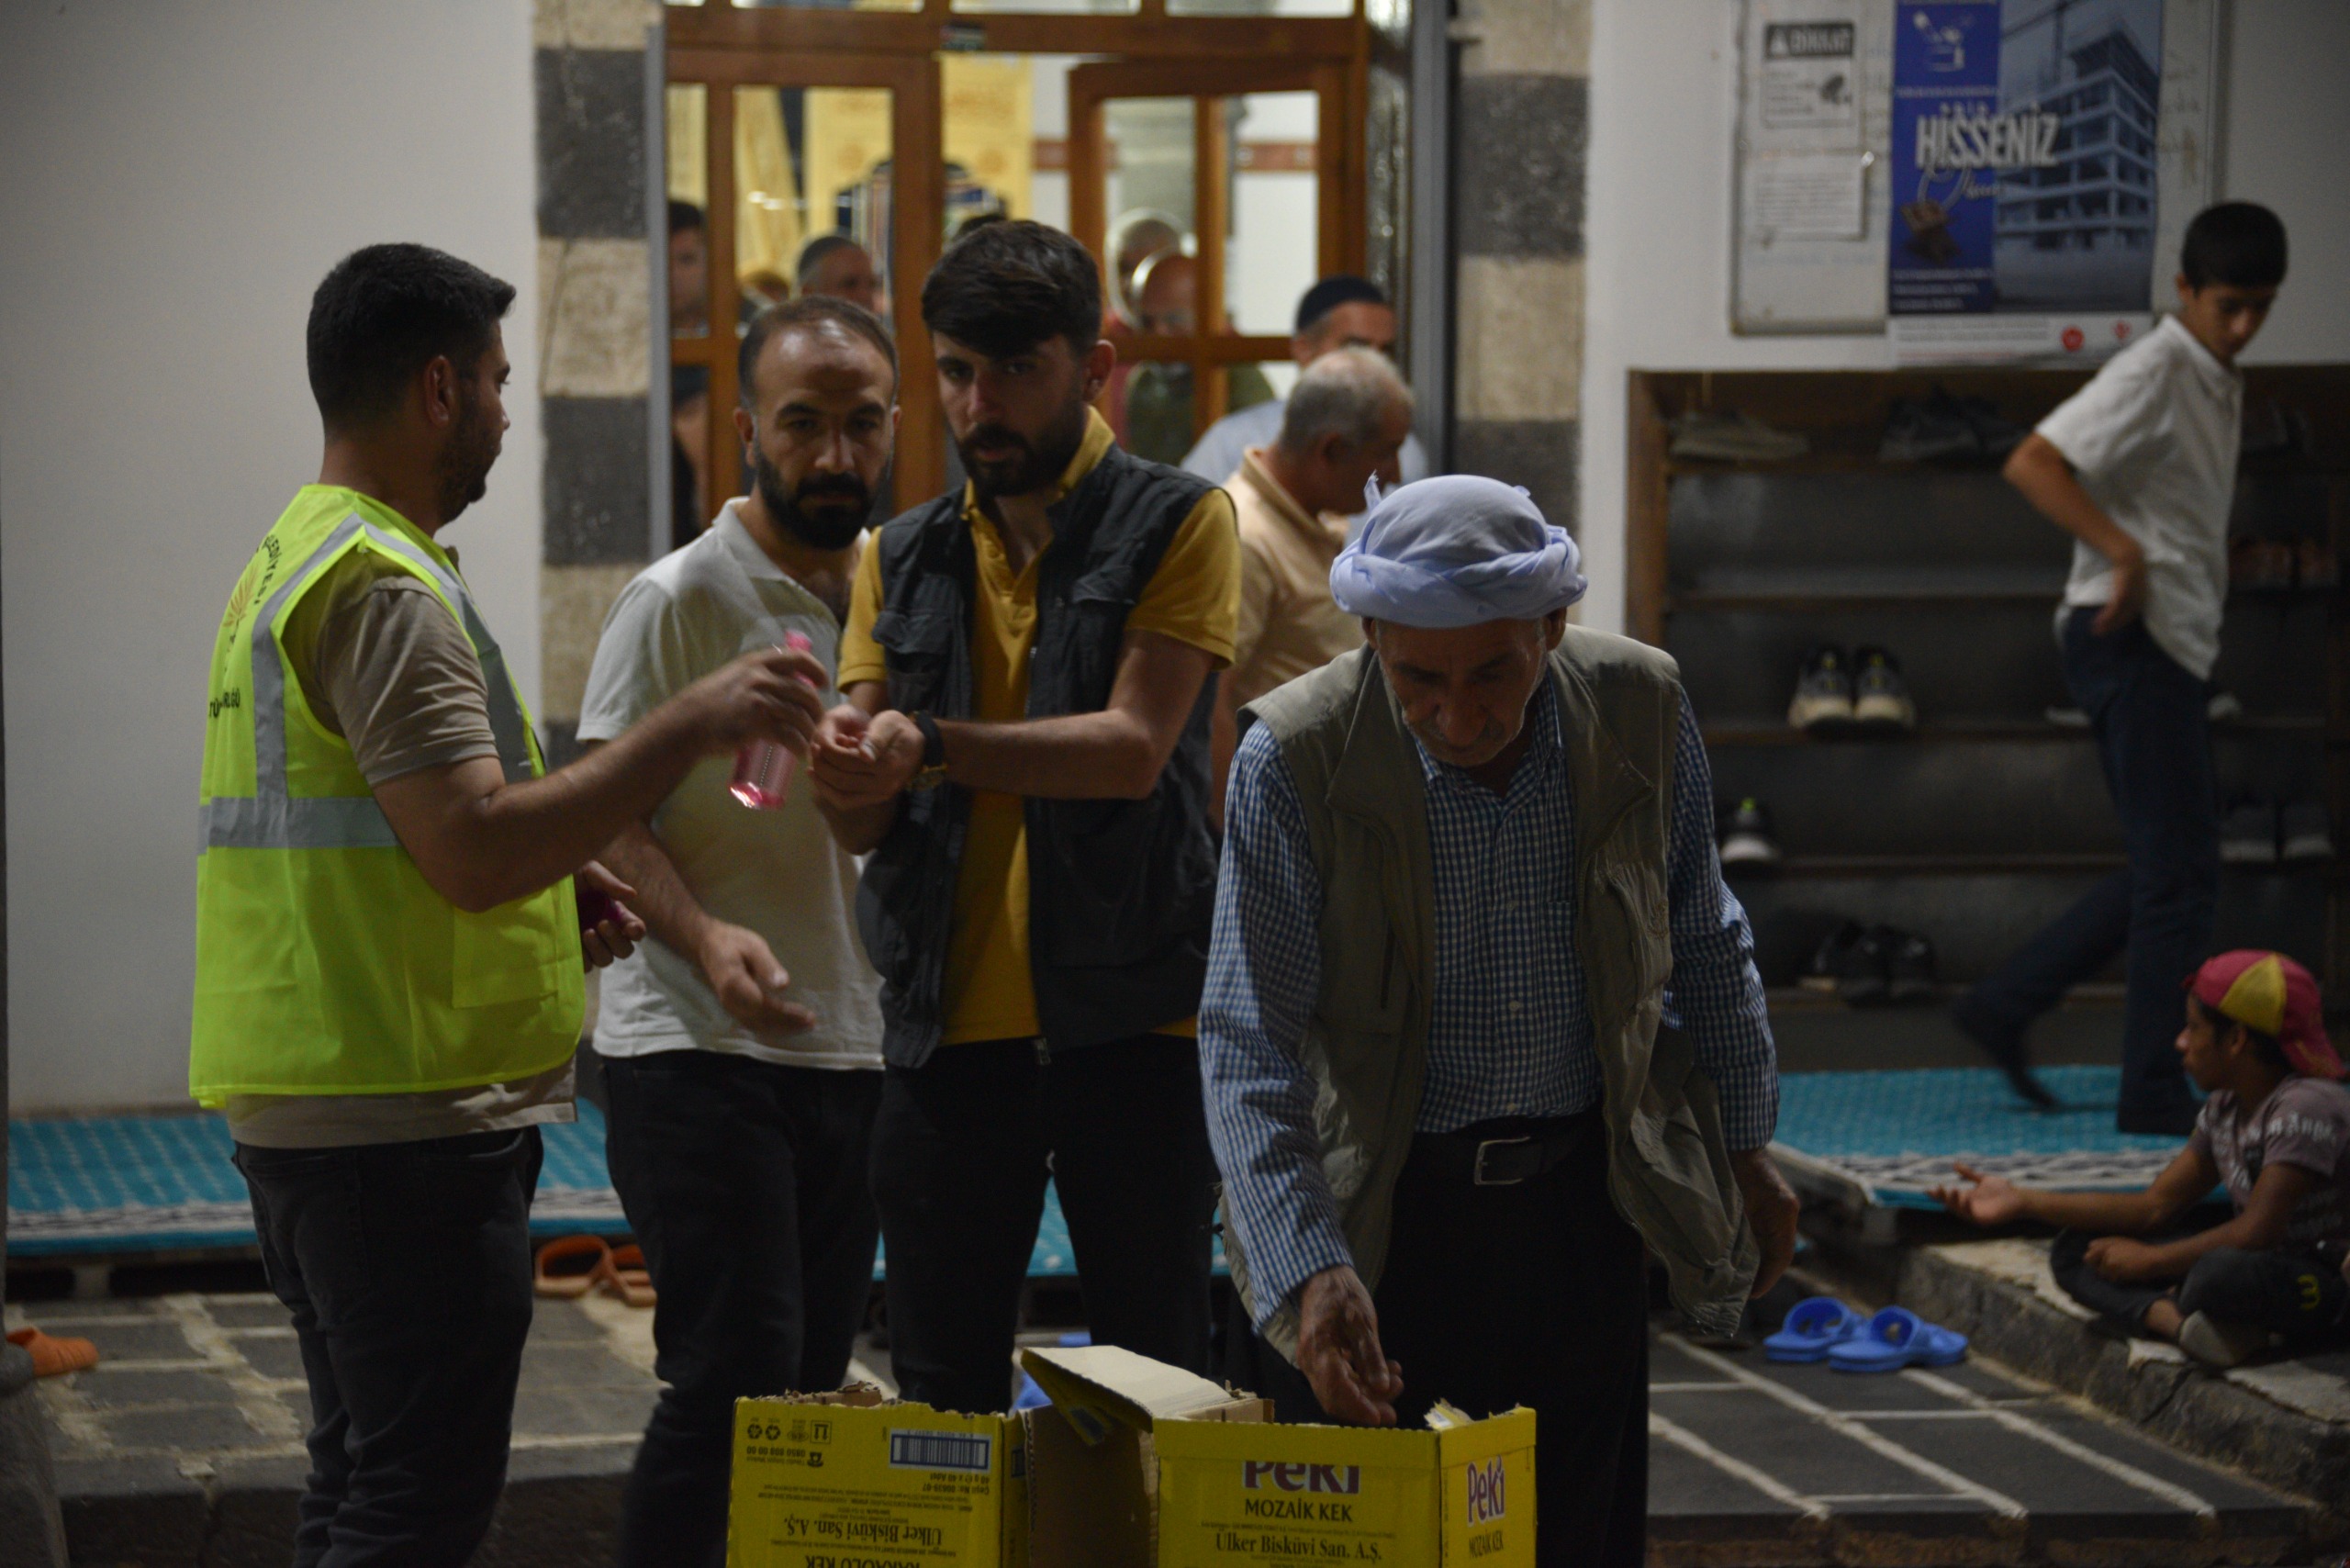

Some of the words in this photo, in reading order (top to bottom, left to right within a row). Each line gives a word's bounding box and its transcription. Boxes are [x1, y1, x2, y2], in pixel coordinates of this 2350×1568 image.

[1467, 1454, 1505, 1528] Peki
[1245, 1498, 1315, 1519] MOZAİK
[1319, 1503, 1353, 1522] KEK
[784, 1515, 810, 1537] A.Ş.
[814, 1519, 843, 1540] San.
[846, 1523, 900, 1546] Bisküvi
[904, 1527, 944, 1551] Ülker
[1216, 1528, 1257, 1551] Ülker
[1261, 1534, 1315, 1556] Bisküvi
[1319, 1537, 1350, 1559] San.
[1355, 1540, 1382, 1565] A.Ş.
